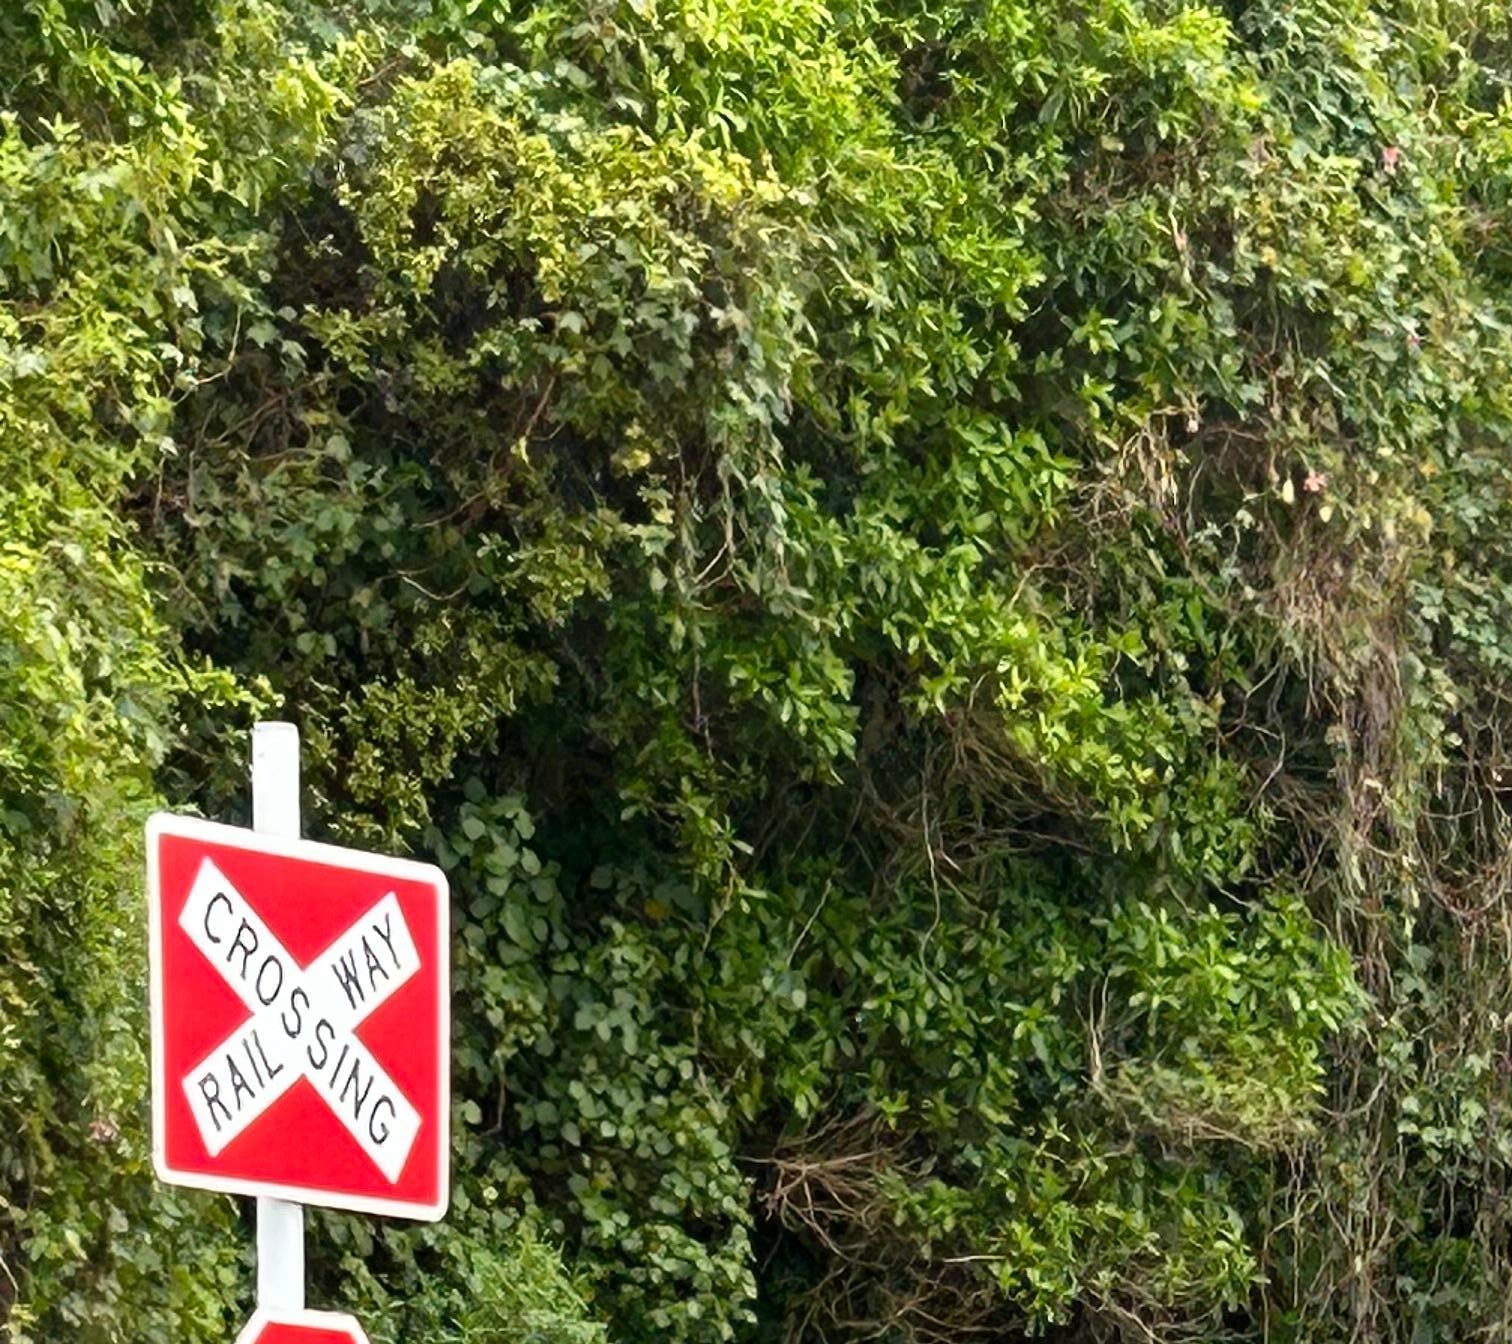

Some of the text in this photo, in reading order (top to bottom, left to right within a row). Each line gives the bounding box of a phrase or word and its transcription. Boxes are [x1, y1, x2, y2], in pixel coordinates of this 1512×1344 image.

[198, 912, 401, 1132] RAIL WAY
[204, 892, 396, 1145] CROSSING
